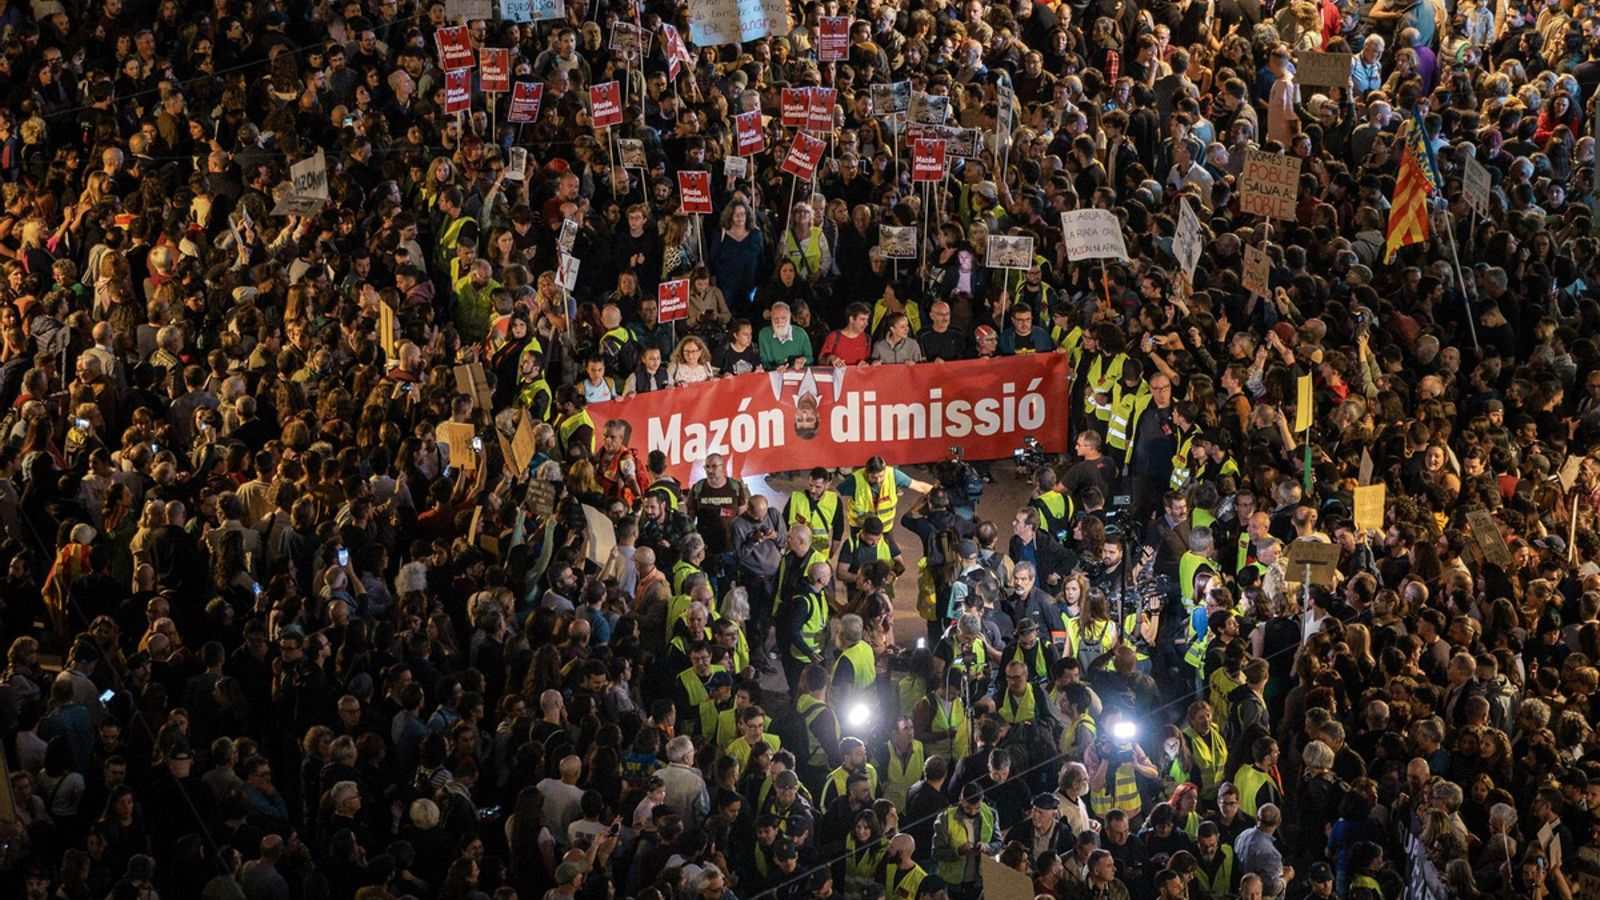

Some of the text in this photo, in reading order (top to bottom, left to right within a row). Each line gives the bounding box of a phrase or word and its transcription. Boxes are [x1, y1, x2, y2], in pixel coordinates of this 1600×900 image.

[1249, 162, 1296, 186] POBLE
[1244, 177, 1281, 197] SALVA
[1244, 192, 1290, 219] POBLE
[646, 377, 1046, 466] Mazón dimissió
